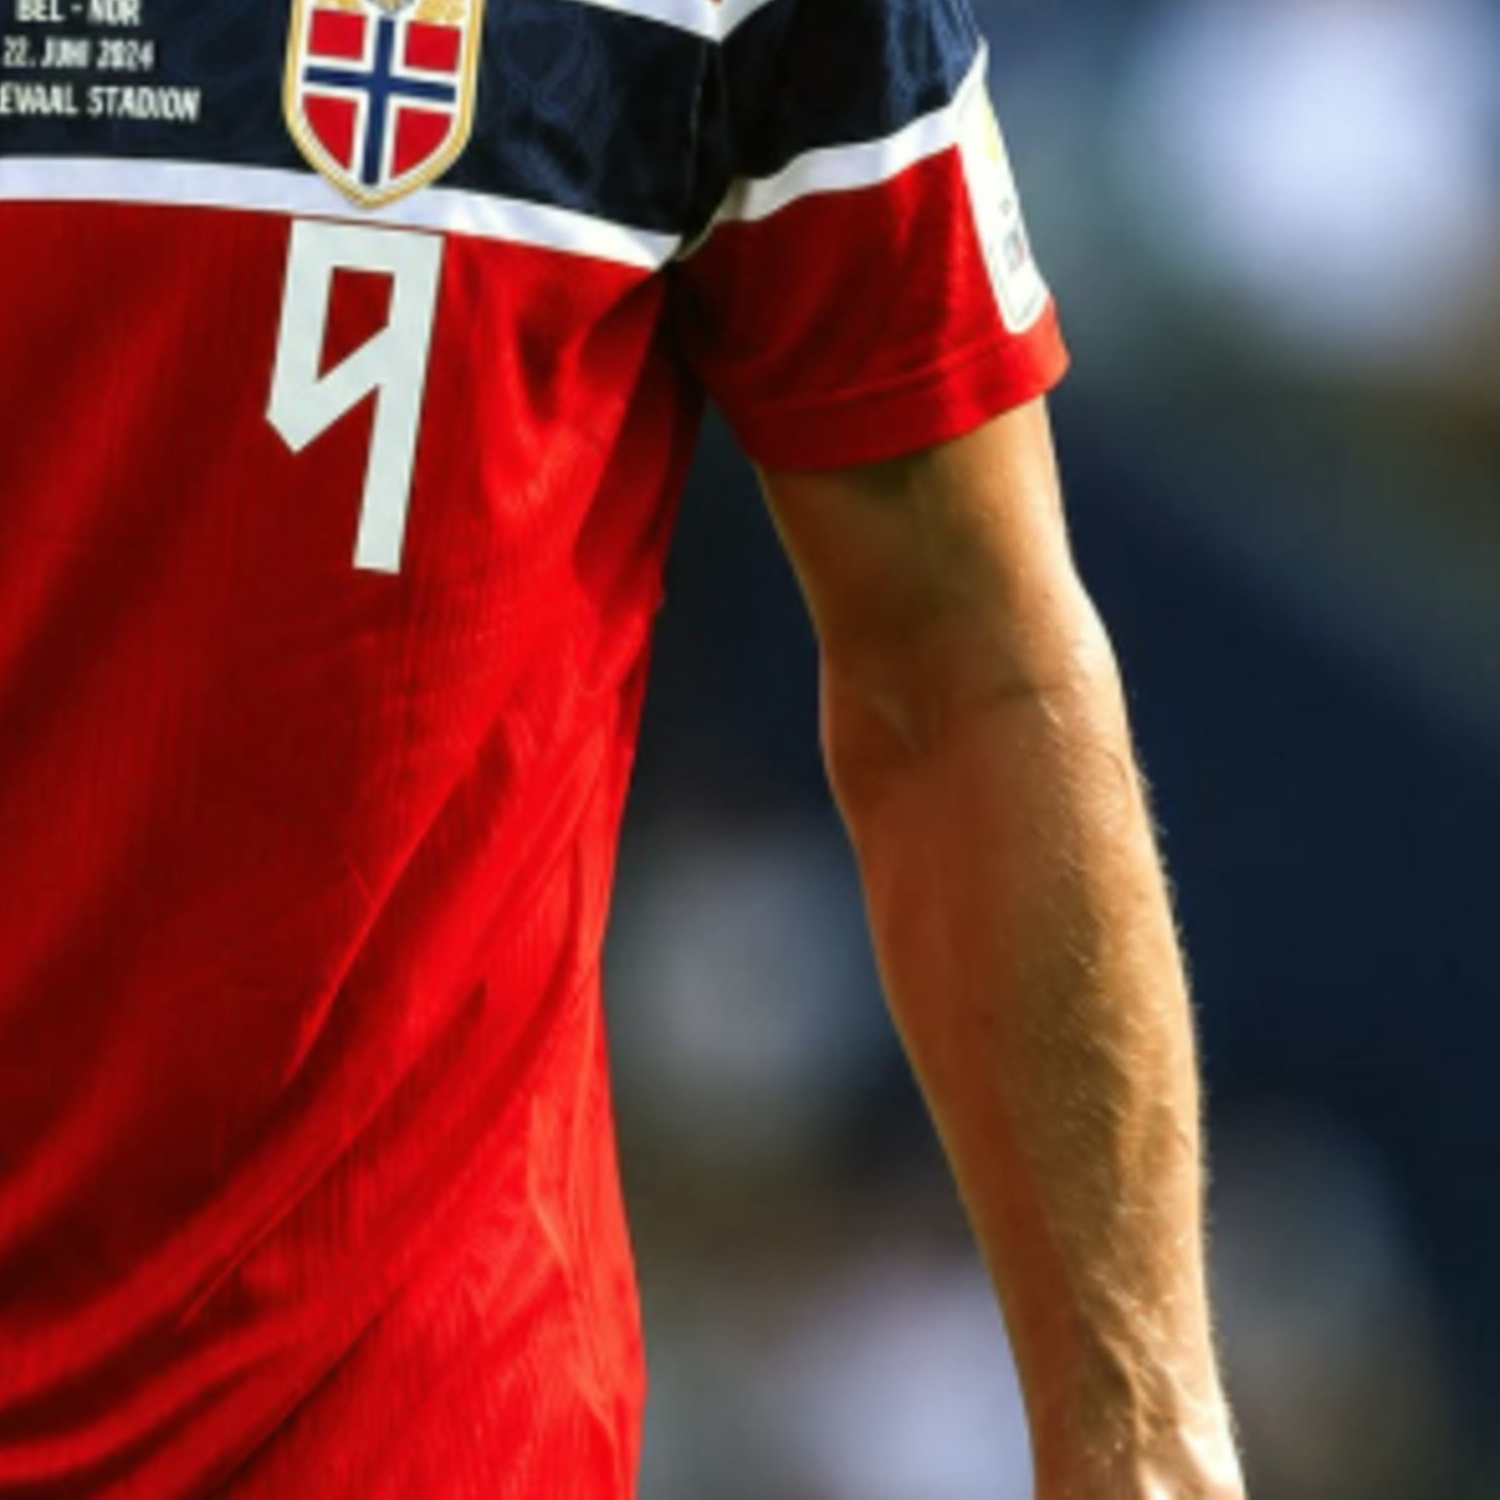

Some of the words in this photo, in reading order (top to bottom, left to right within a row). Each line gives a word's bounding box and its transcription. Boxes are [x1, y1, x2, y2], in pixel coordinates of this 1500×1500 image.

[96, 38, 155, 71] 2024
[87, 85, 201, 123] STADION
[265, 218, 446, 574] 9
